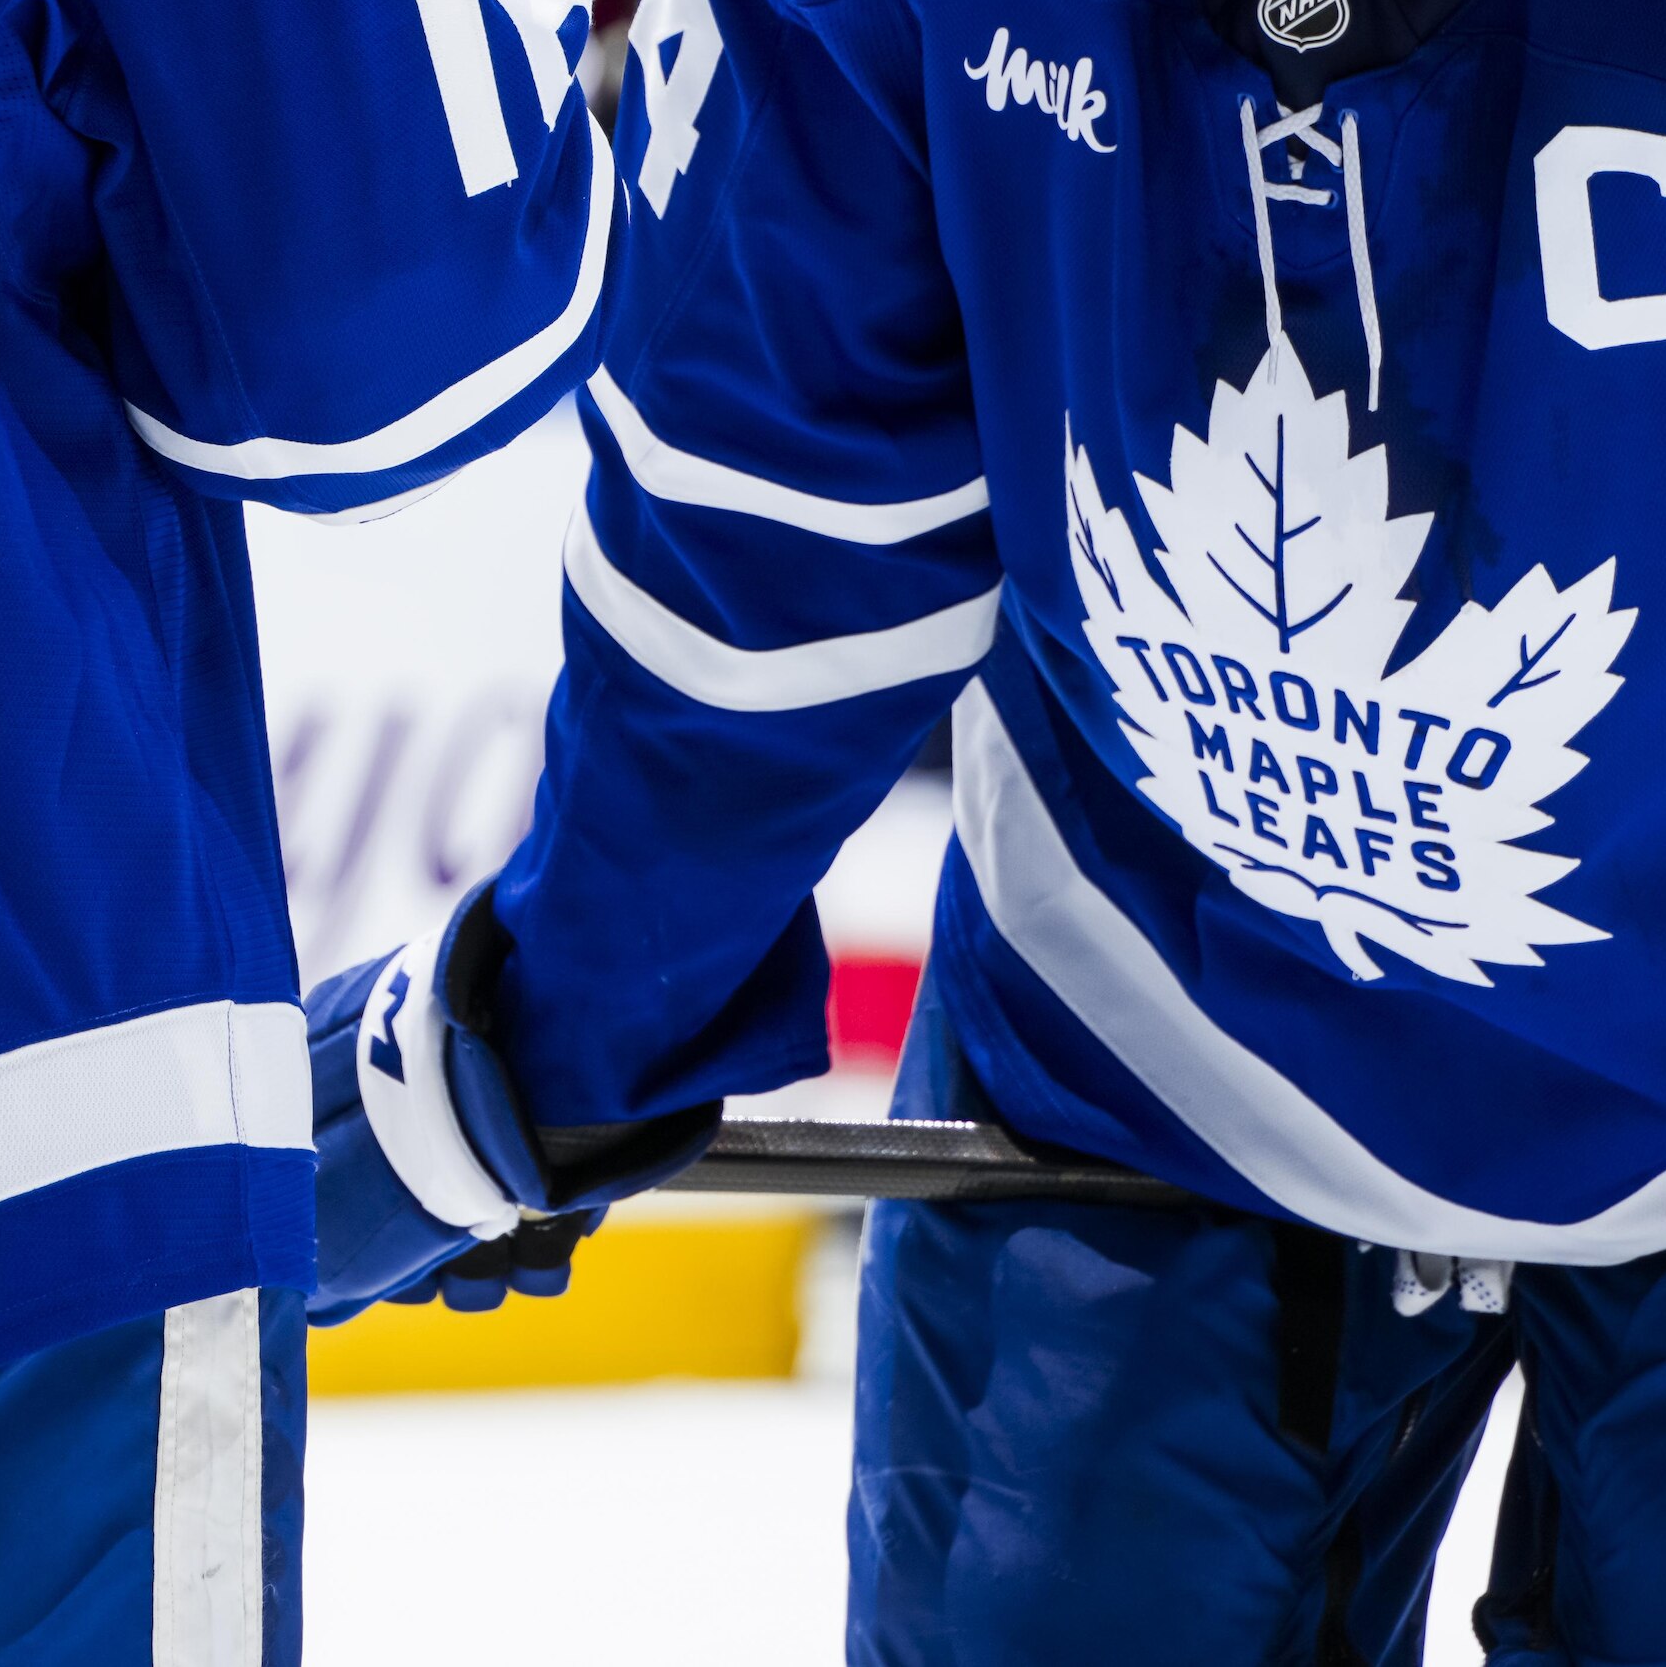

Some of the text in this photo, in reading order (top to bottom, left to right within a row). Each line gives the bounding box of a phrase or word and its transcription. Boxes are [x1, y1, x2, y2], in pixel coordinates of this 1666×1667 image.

[963, 26, 1118, 154] Milk
[1116, 635, 1512, 790] TORONTO
[1184, 709, 1450, 834] MAPLE
[1198, 769, 1461, 893] LEAFS
